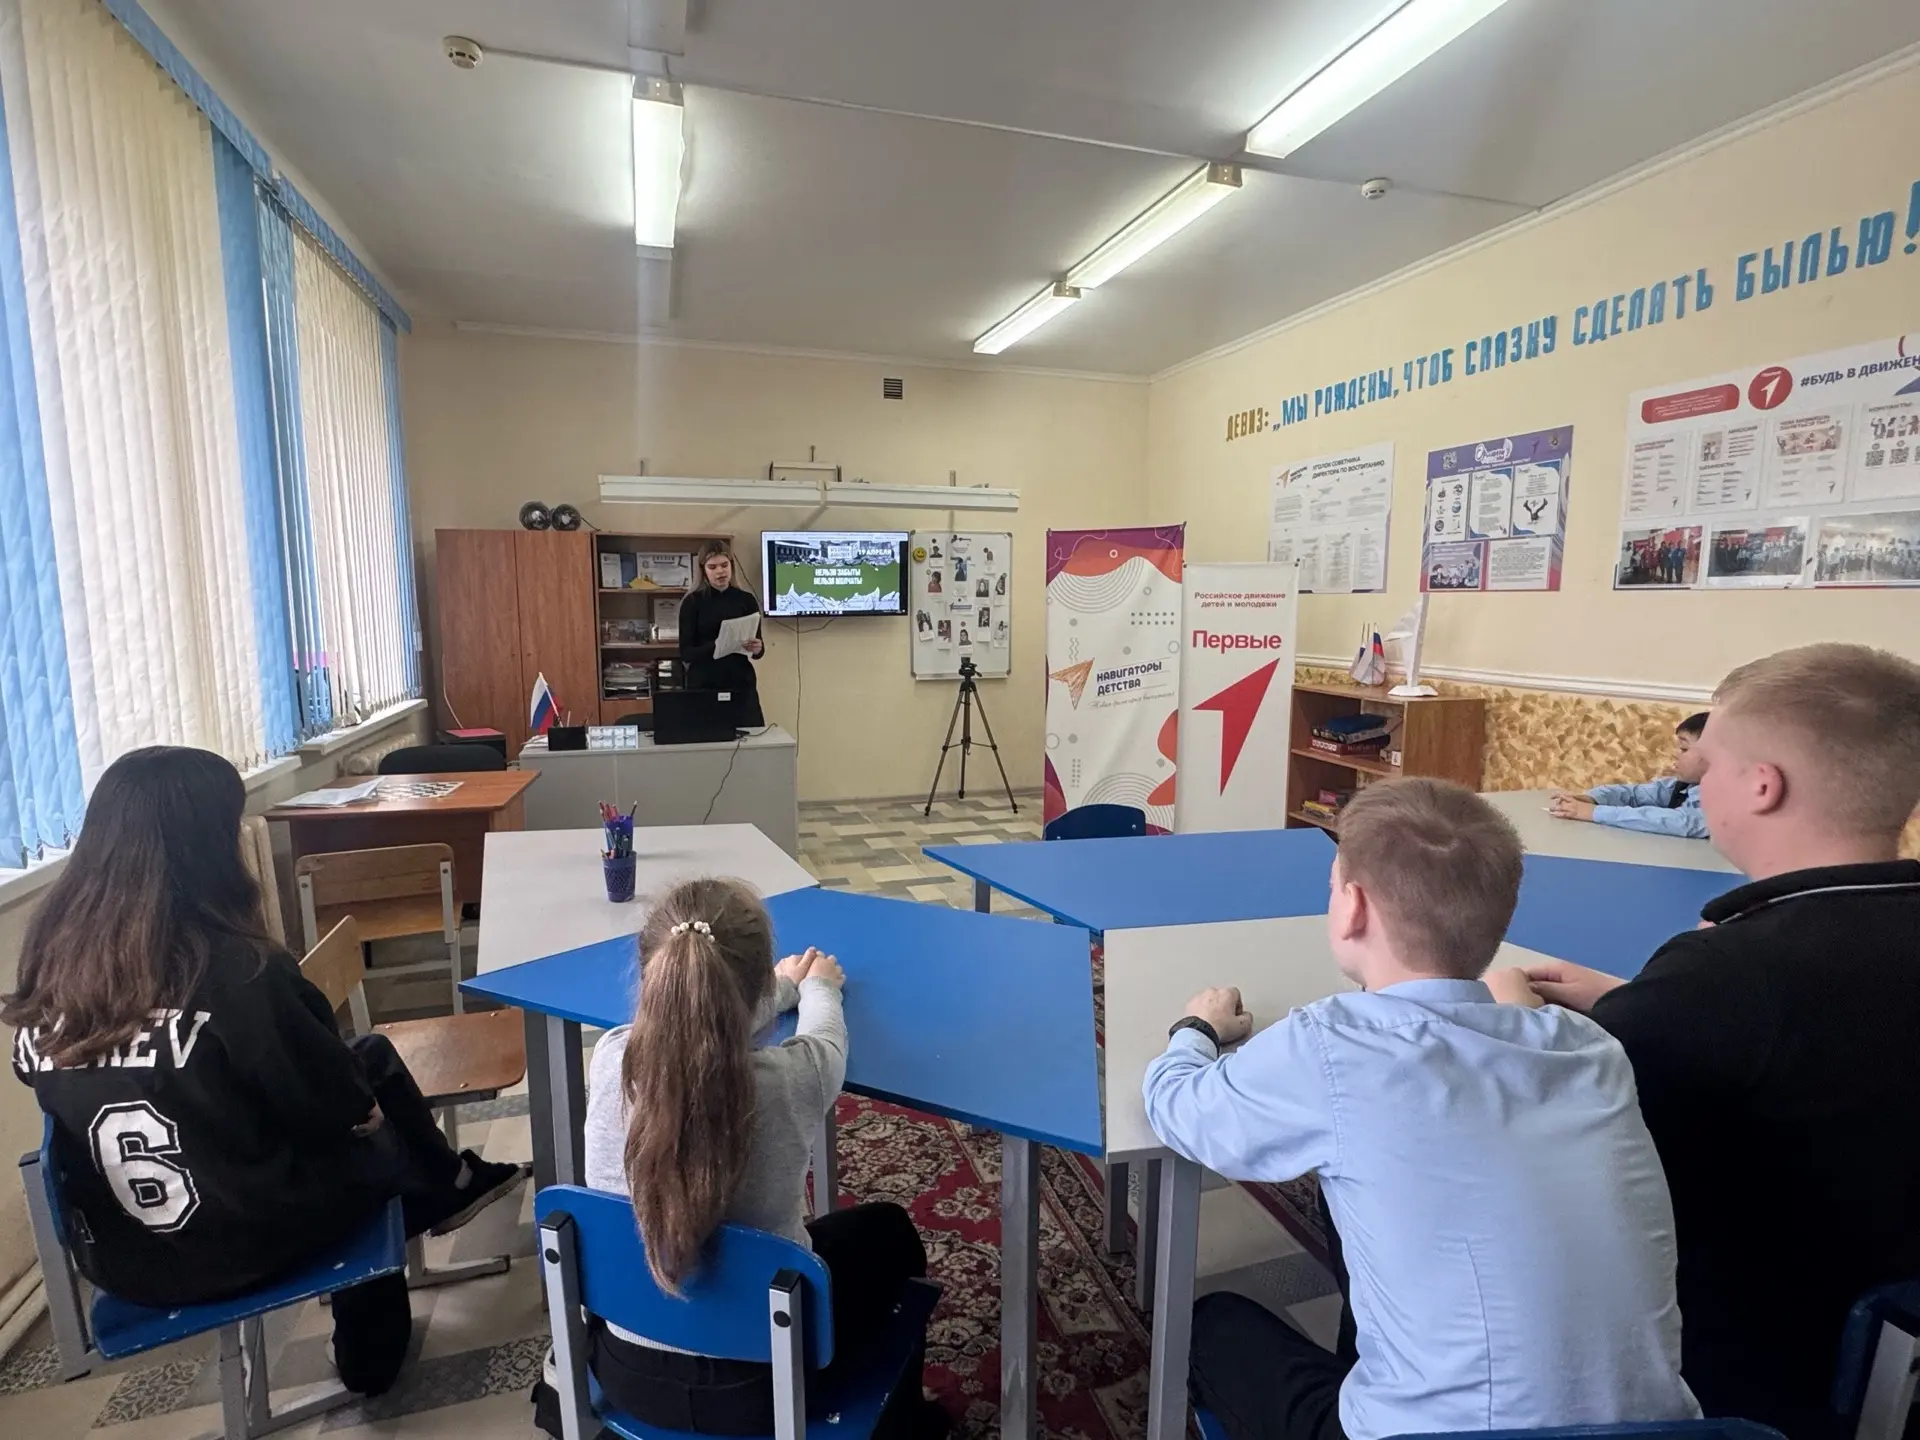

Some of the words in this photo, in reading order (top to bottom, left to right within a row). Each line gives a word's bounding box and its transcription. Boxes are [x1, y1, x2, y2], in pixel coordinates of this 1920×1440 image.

[1226, 407, 1269, 441] ДЕВИЗ:
[1314, 367, 1400, 418] РОЖДЕНЫ,
[1403, 348, 1454, 392] ЧТОБ
[1465, 315, 1558, 376] СКАЗКУ
[1572, 267, 1714, 346] СДЕЛАТЬ
[1801, 371, 1844, 387] #БУДЬ
[1847, 368, 1856, 378] В
[1311, 468, 1340, 479] ДИРЕКТОРА
[1348, 460, 1385, 472] ВОСПИТАНИЮ
[1331, 456, 1361, 467] СОВЕТНИКА
[1194, 592, 1242, 600] Российское
[1244, 592, 1286, 601] движение
[1201, 600, 1226, 608] детей
[1235, 600, 1277, 608] молодежи
[1192, 630, 1282, 654] Первые
[1096, 661, 1162, 683] НАВИГАТОРЫ
[1097, 678, 1141, 697] ДЕТСТВА
[88, 1100, 200, 1233] 6
